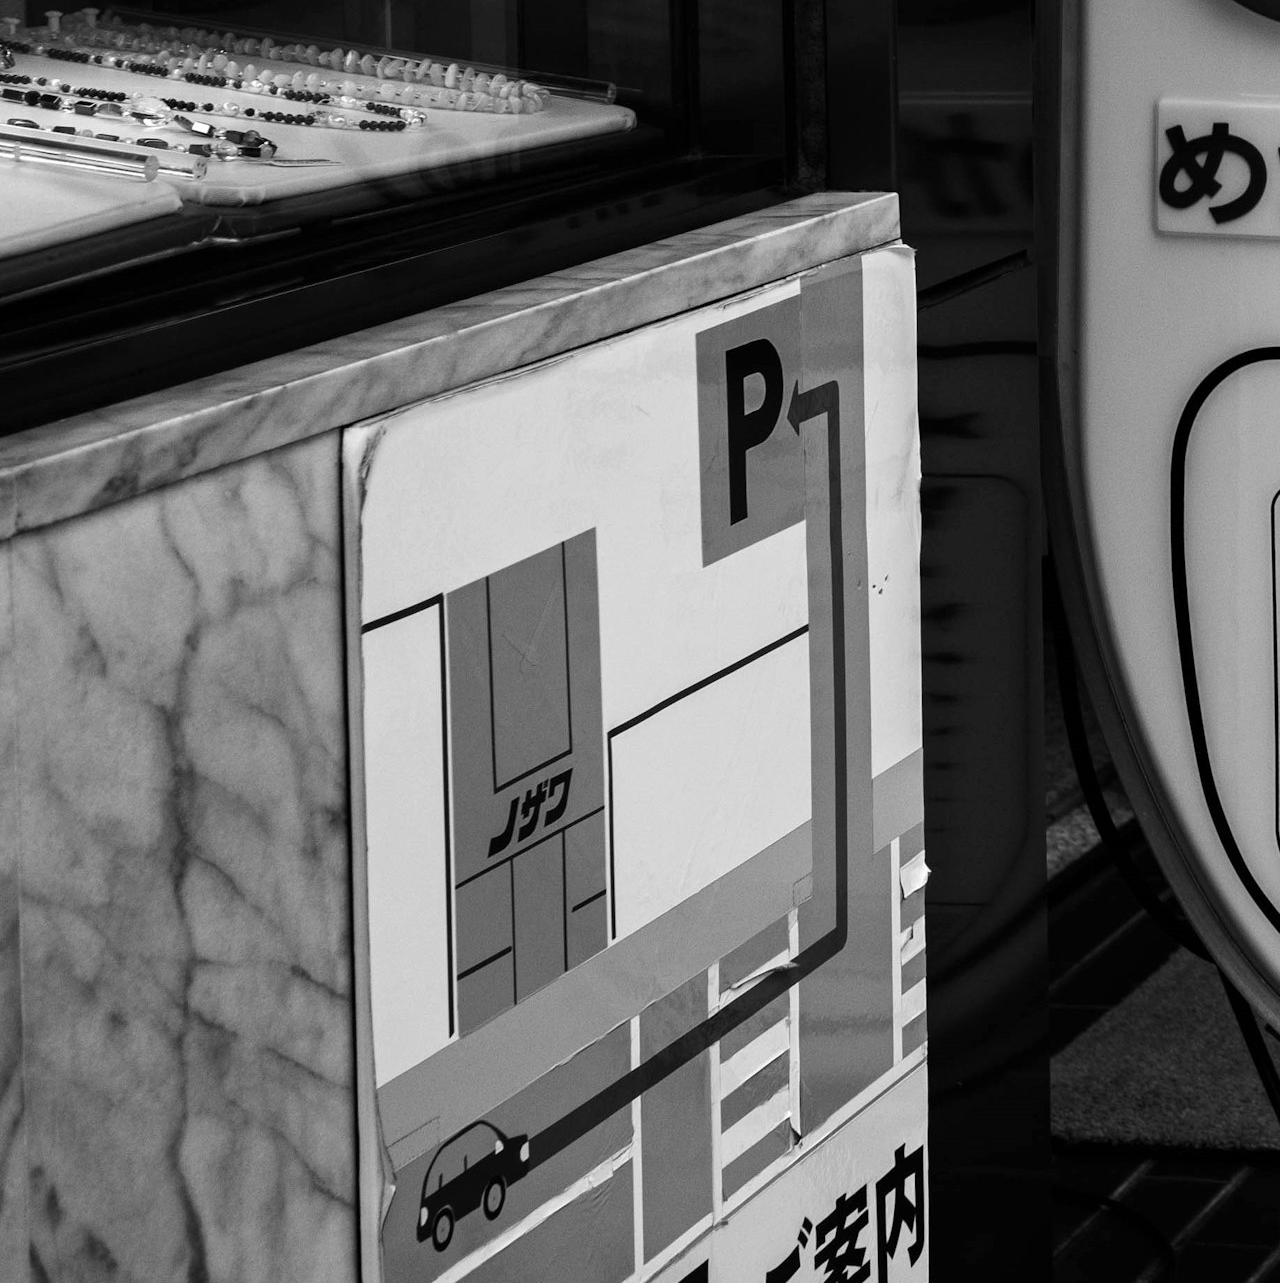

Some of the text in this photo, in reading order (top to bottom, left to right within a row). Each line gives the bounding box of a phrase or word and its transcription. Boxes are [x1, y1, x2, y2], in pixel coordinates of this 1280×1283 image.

[725, 338, 784, 526] P
[487, 767, 574, 859] ノザワ
